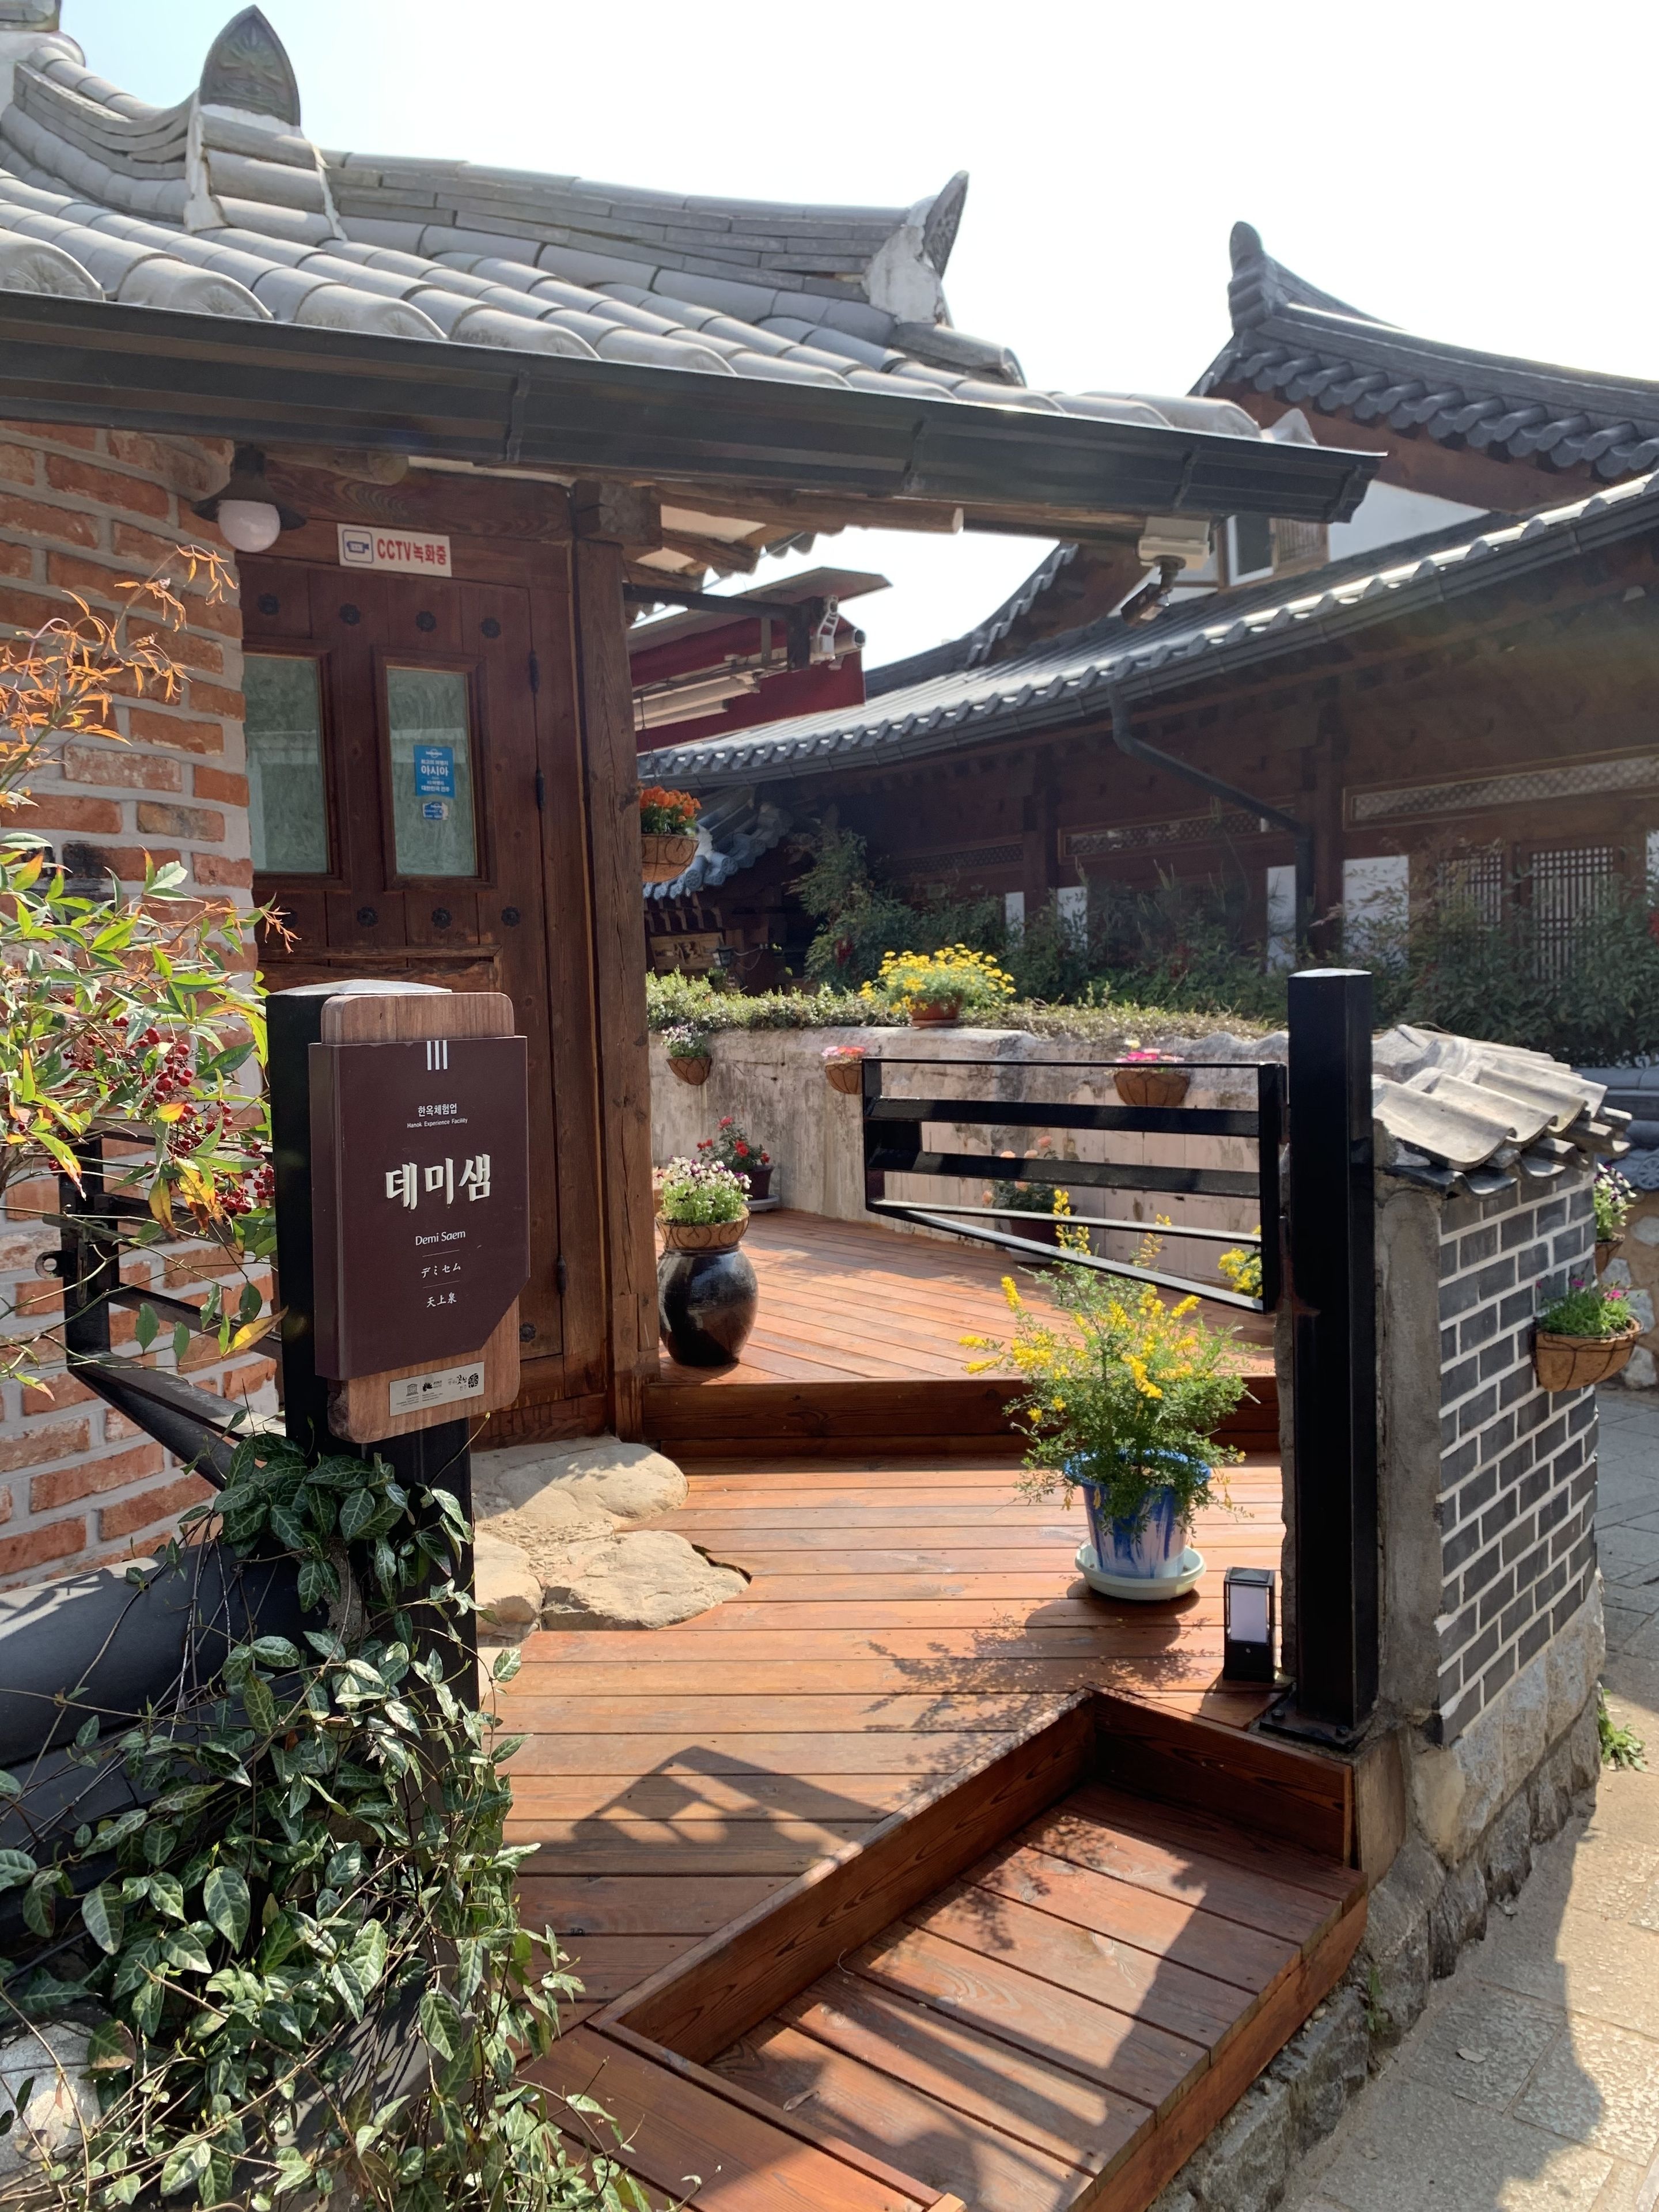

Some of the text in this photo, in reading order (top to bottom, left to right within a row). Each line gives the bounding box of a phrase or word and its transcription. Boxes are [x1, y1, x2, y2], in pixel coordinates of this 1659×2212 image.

[377, 538, 446, 565] CCTV녹화중
[421, 766, 449, 777] 아시아
[418, 1103, 457, 1117] 한옥체험업
[424, 1119, 450, 1127] Experience
[385, 1153, 491, 1210] 데미샘
[415, 1230, 466, 1246] Demi Saem
[421, 1263, 461, 1279] デミセム
[426, 1291, 457, 1308] 天上泉
